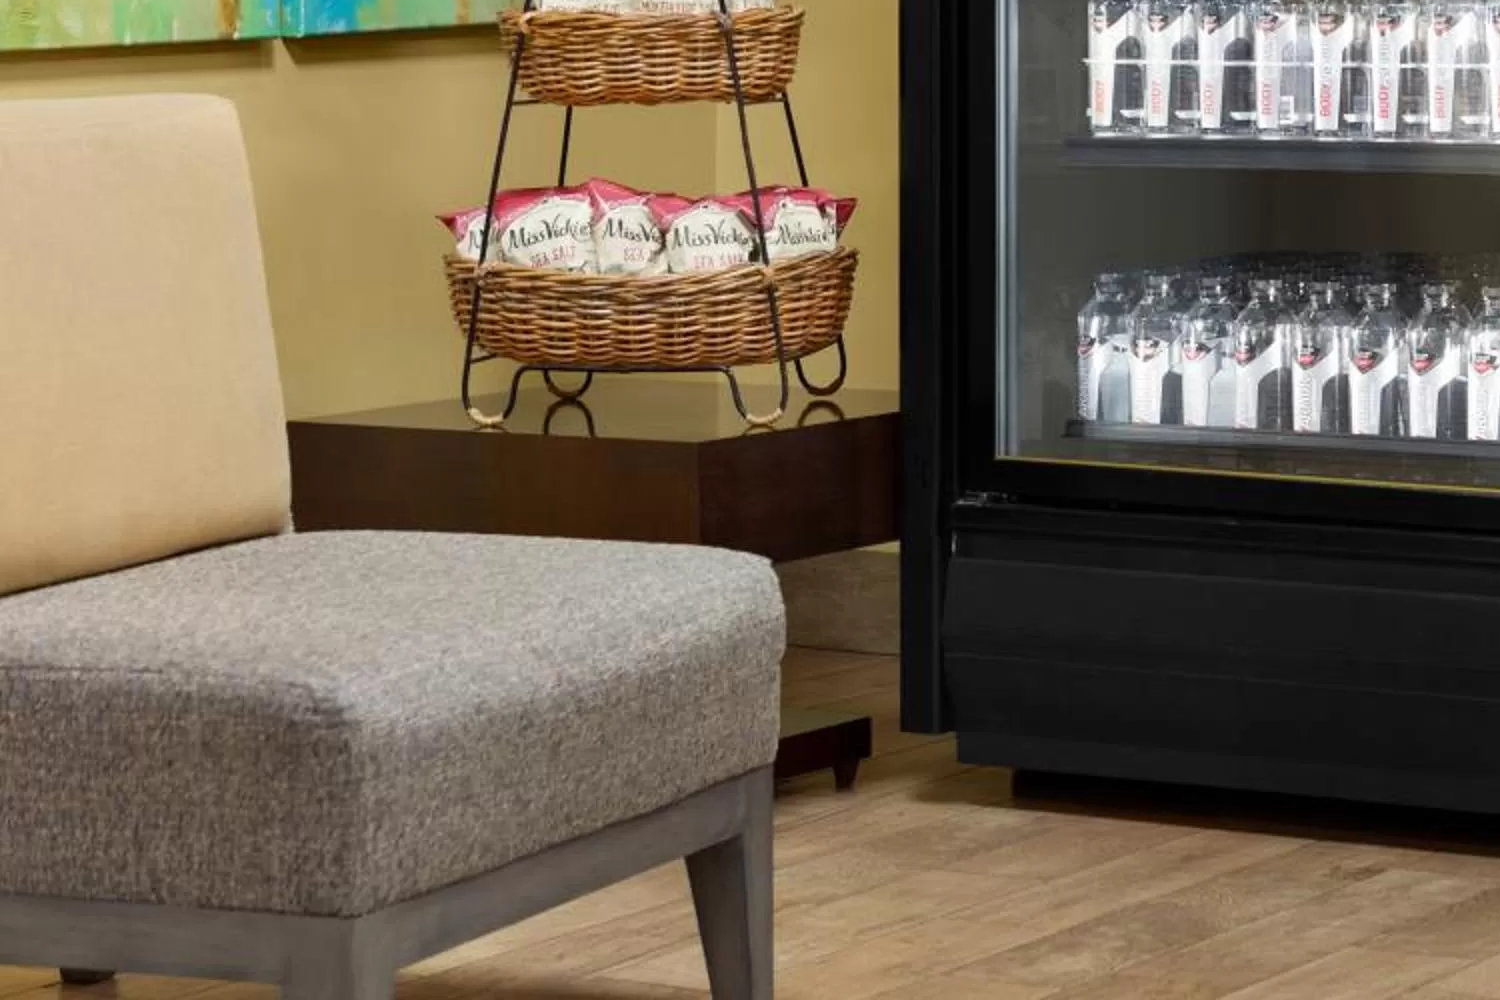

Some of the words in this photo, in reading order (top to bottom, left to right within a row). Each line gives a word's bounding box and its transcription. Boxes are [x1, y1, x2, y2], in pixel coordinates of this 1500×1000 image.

[508, 226, 544, 252] Miss
[602, 217, 642, 243] Miss
[672, 225, 710, 250] Miss
[552, 245, 577, 261] SALT
